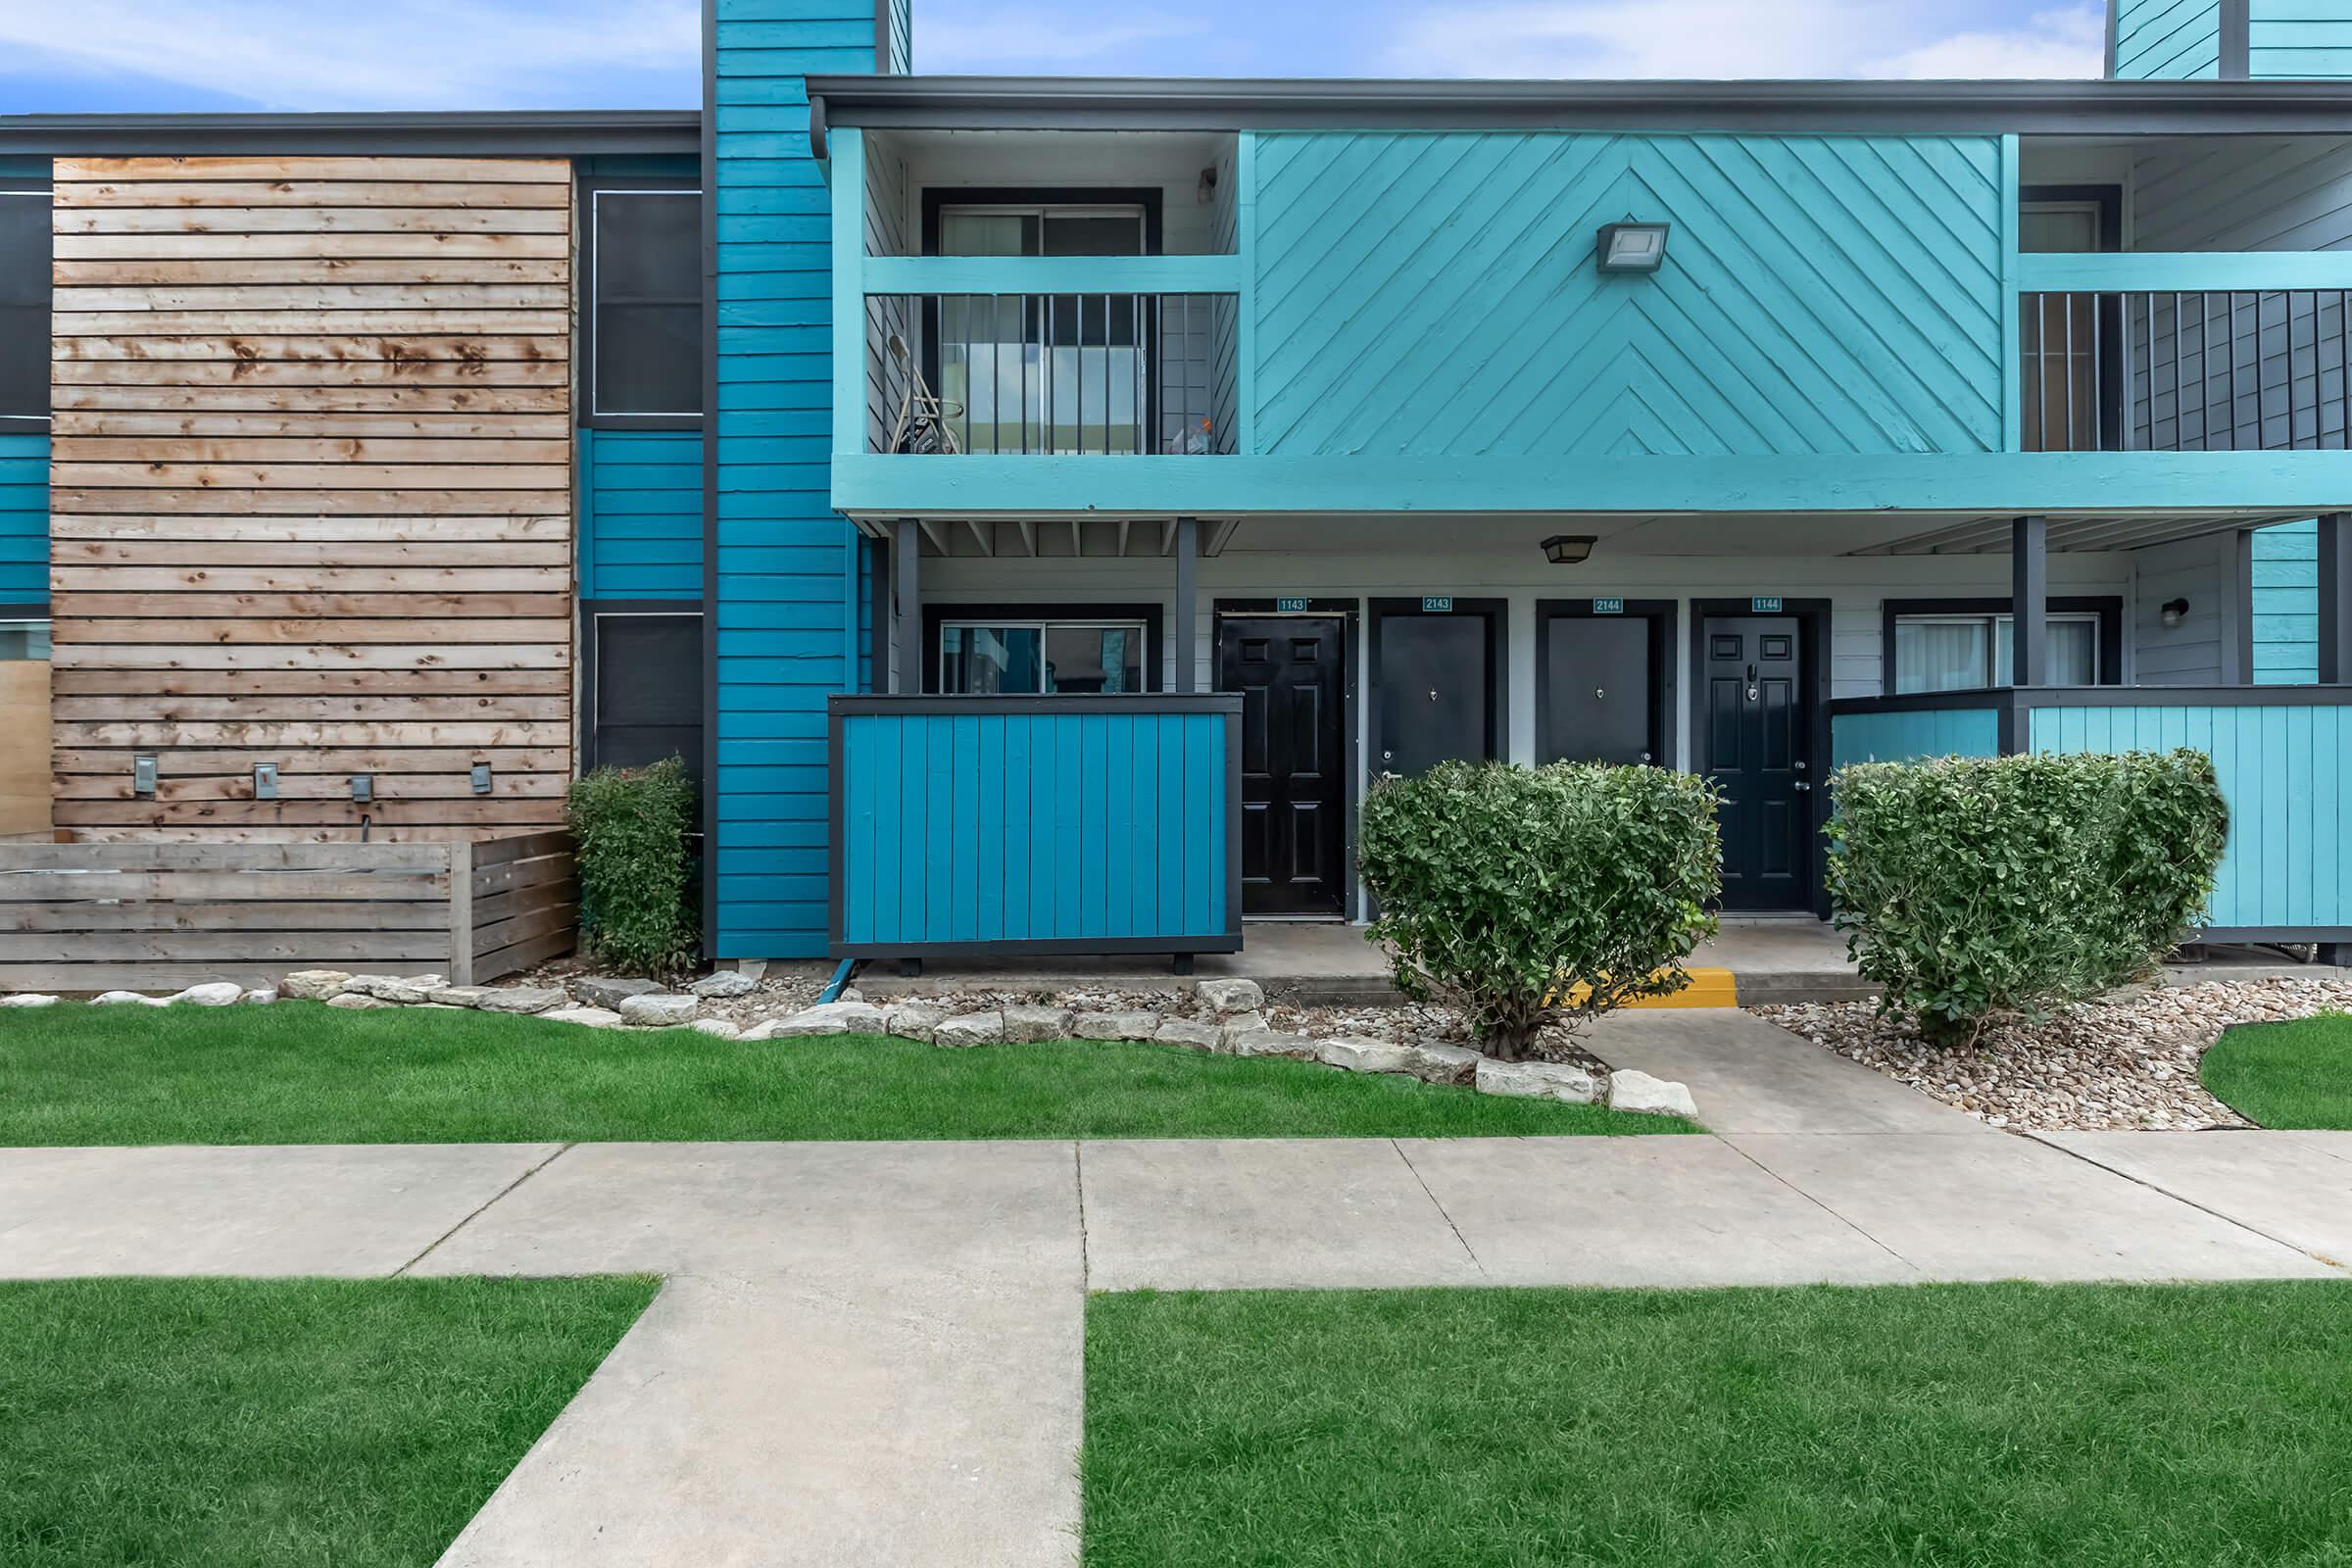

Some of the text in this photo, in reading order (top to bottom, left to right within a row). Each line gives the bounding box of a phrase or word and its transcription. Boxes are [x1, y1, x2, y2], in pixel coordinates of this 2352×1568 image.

[1282, 600, 1303, 610] 1143
[1426, 599, 1448, 609] 2143
[1596, 600, 1619, 610] 2144
[1756, 599, 1778, 609] 1144
